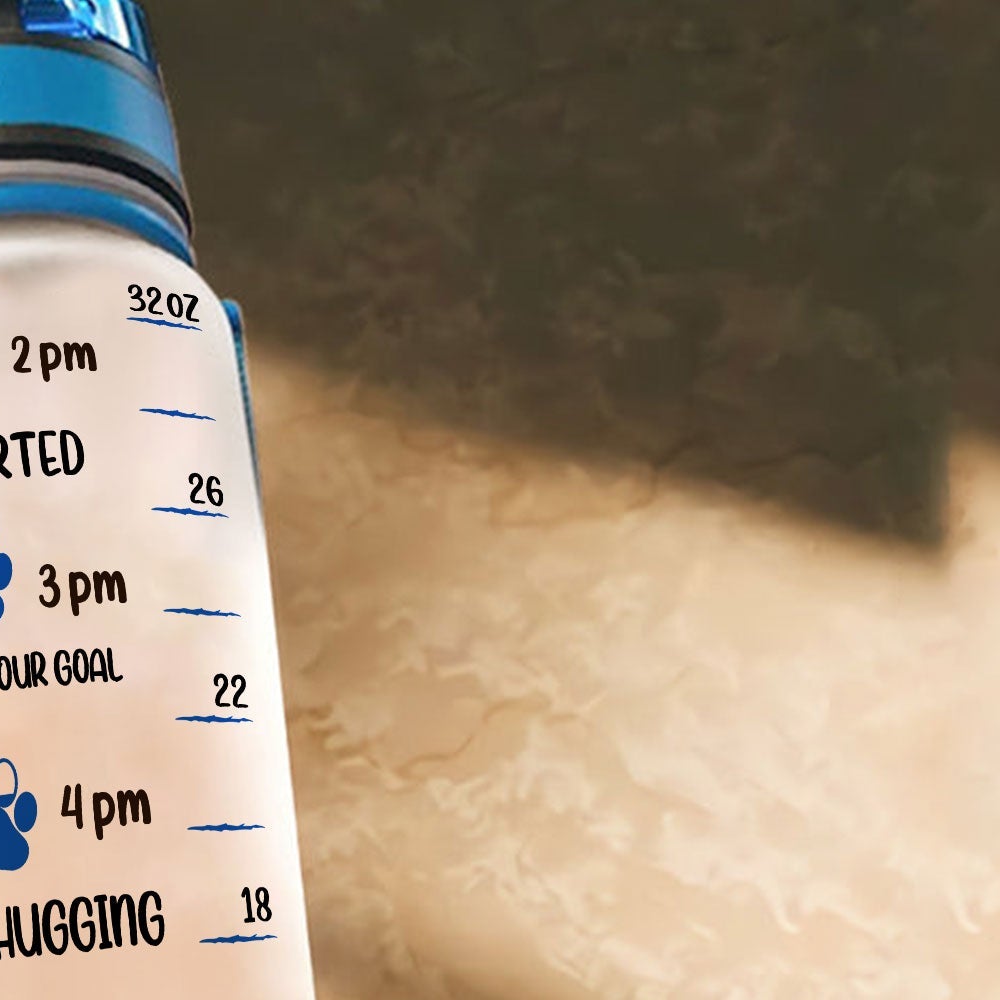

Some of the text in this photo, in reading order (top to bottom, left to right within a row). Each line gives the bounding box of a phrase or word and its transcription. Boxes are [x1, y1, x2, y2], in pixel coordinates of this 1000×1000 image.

[188, 472, 224, 507] 26
[53, 647, 124, 687] GOAL
[213, 673, 249, 709] 22
[240, 886, 273, 924] 18
